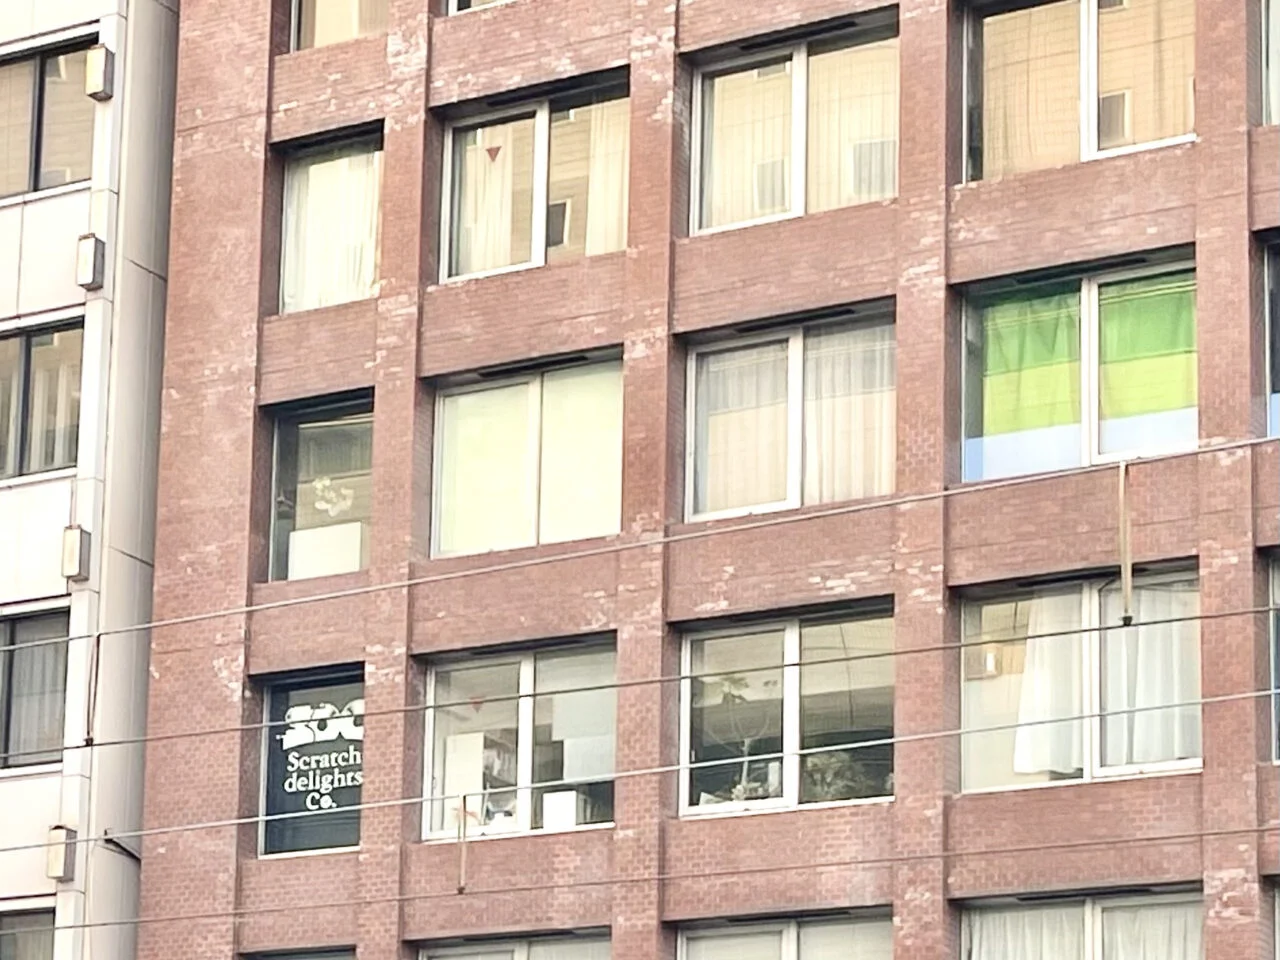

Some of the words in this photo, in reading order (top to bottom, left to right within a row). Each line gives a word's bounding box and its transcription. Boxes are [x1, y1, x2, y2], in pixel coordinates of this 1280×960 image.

[286, 745, 362, 772] Scratch
[283, 768, 363, 794] delights
[305, 792, 338, 810] Co.
